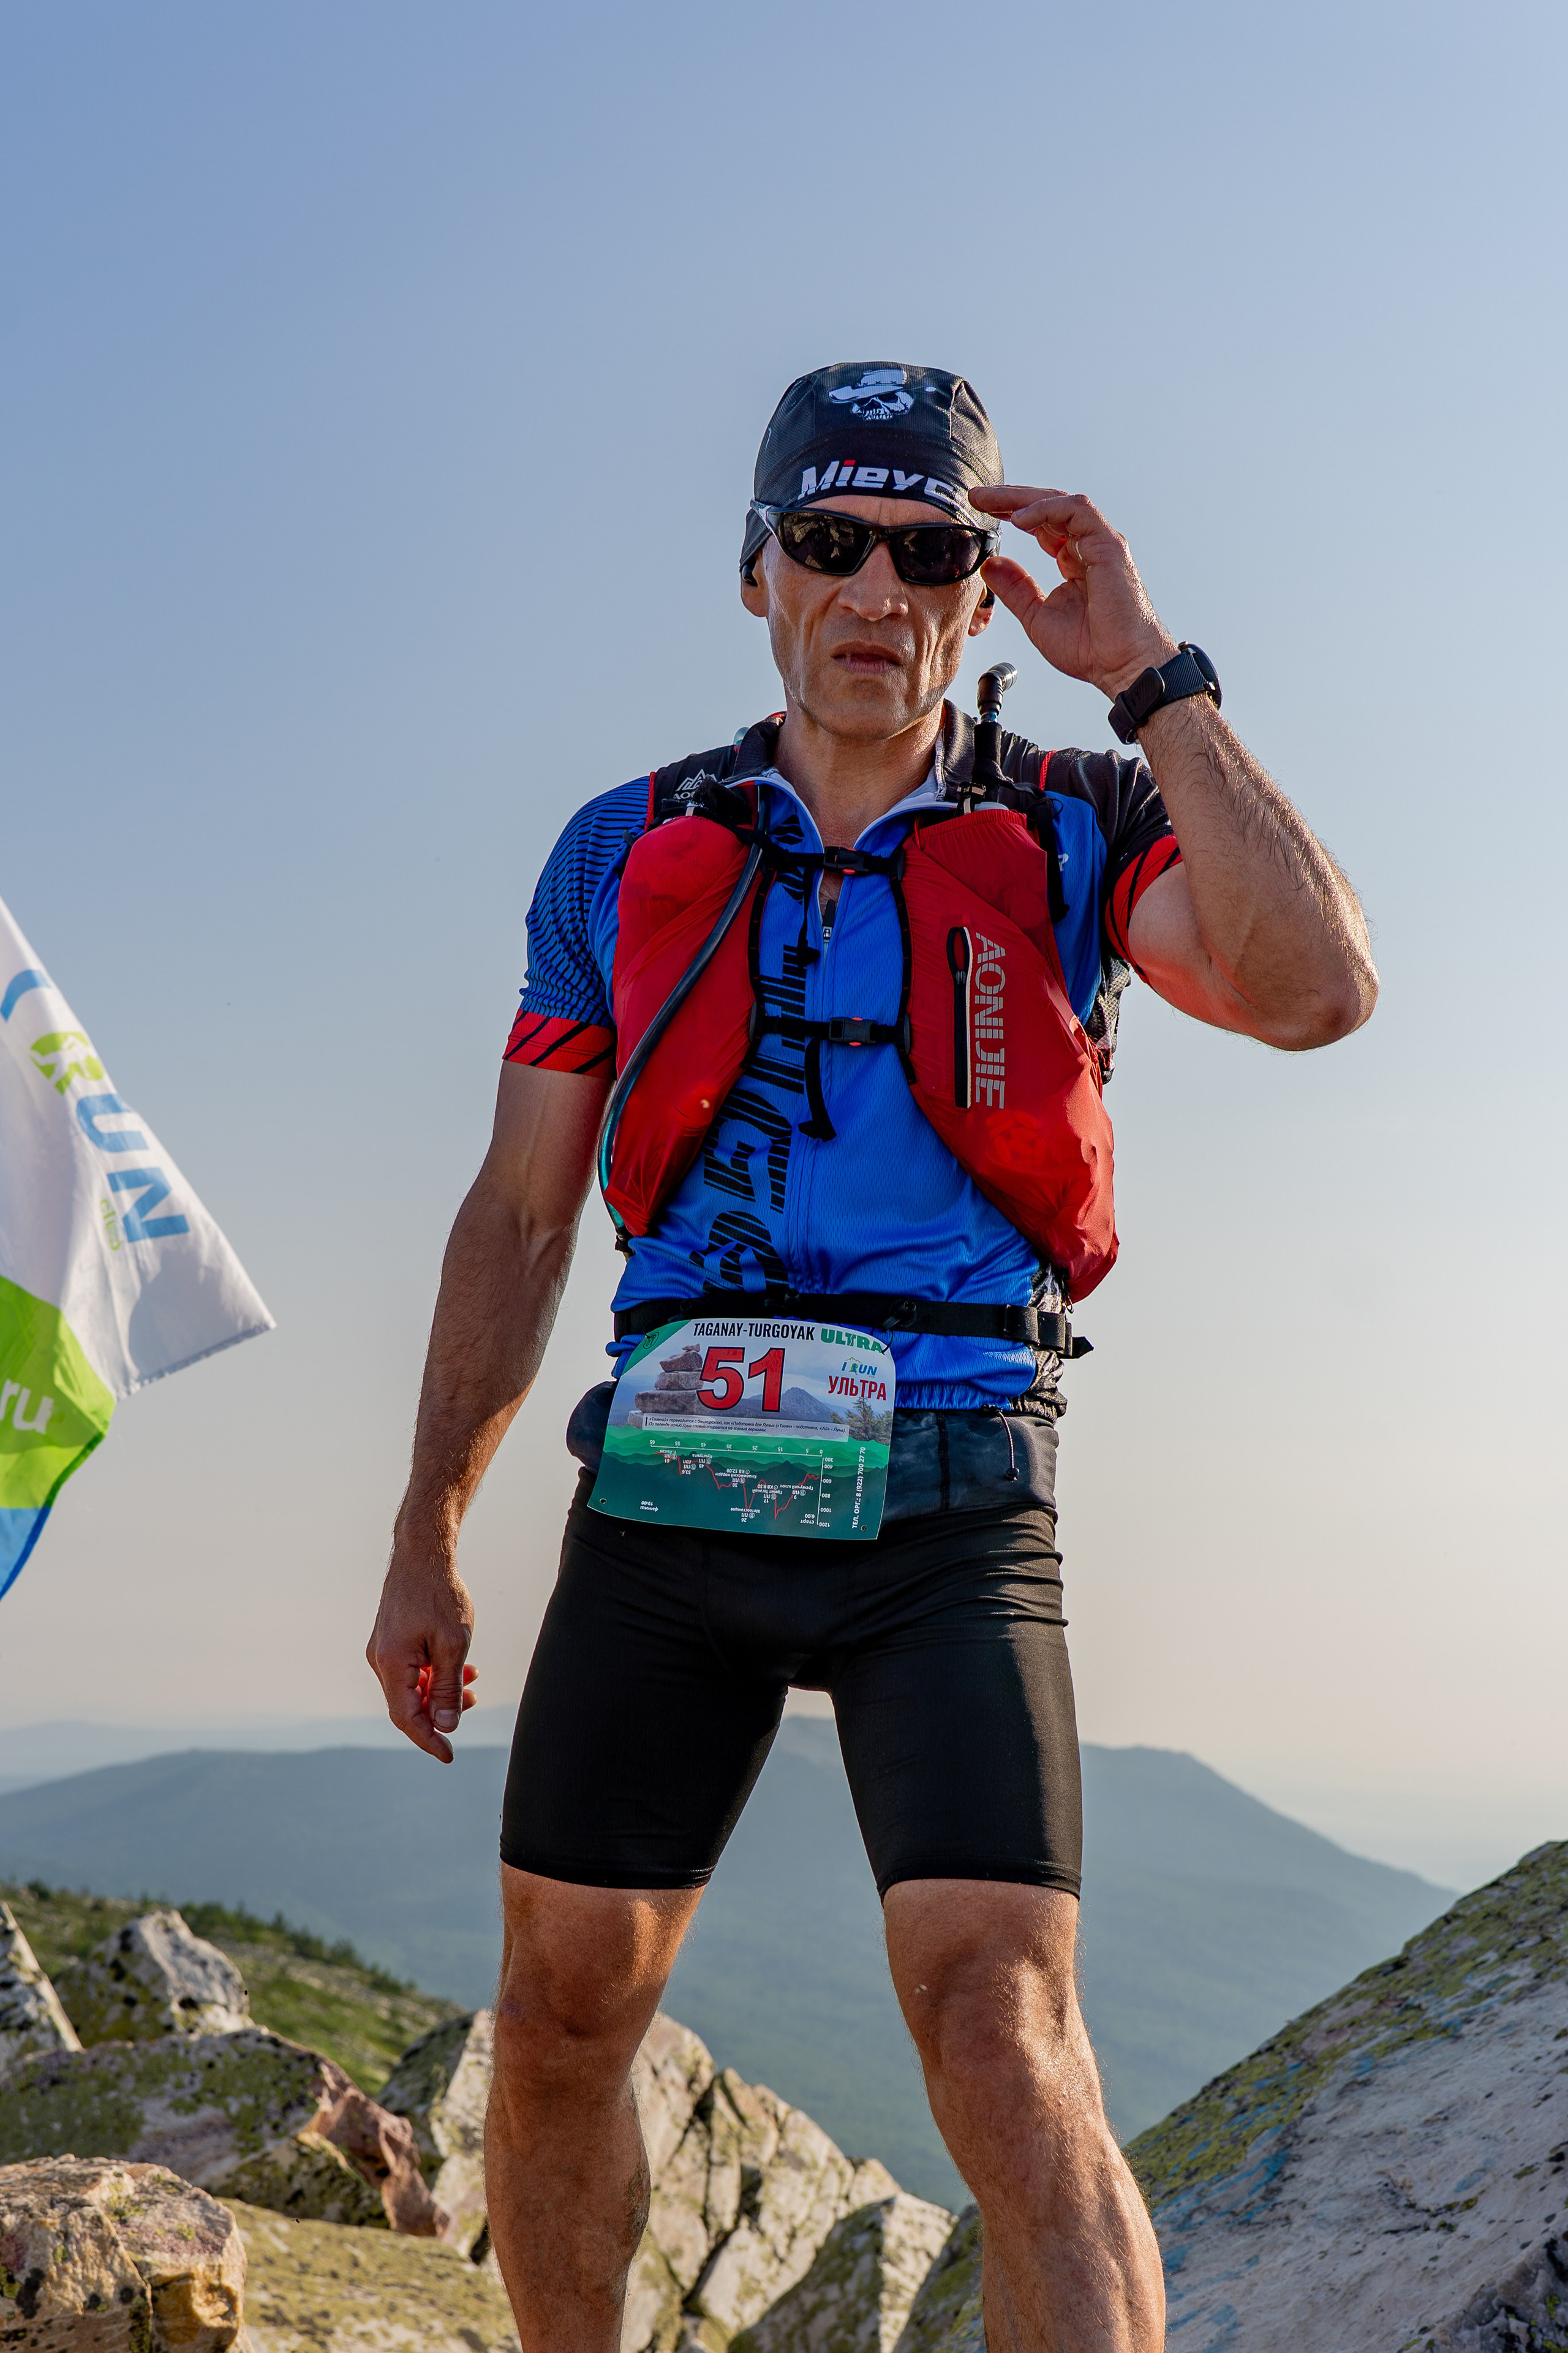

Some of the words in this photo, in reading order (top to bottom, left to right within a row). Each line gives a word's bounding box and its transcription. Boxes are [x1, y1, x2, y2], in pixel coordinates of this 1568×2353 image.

[974, 932, 1006, 1109] AONIJIE
[693, 1323, 815, 1341] TAGANAY-TURGOYAK
[820, 1328, 884, 1354] ULTRA
[696, 1346, 786, 1413] 51
[849, 1362, 878, 1376] RUN
[828, 1375, 886, 1401] УЛЬТРА
[856, 1476, 864, 1492] (922)
